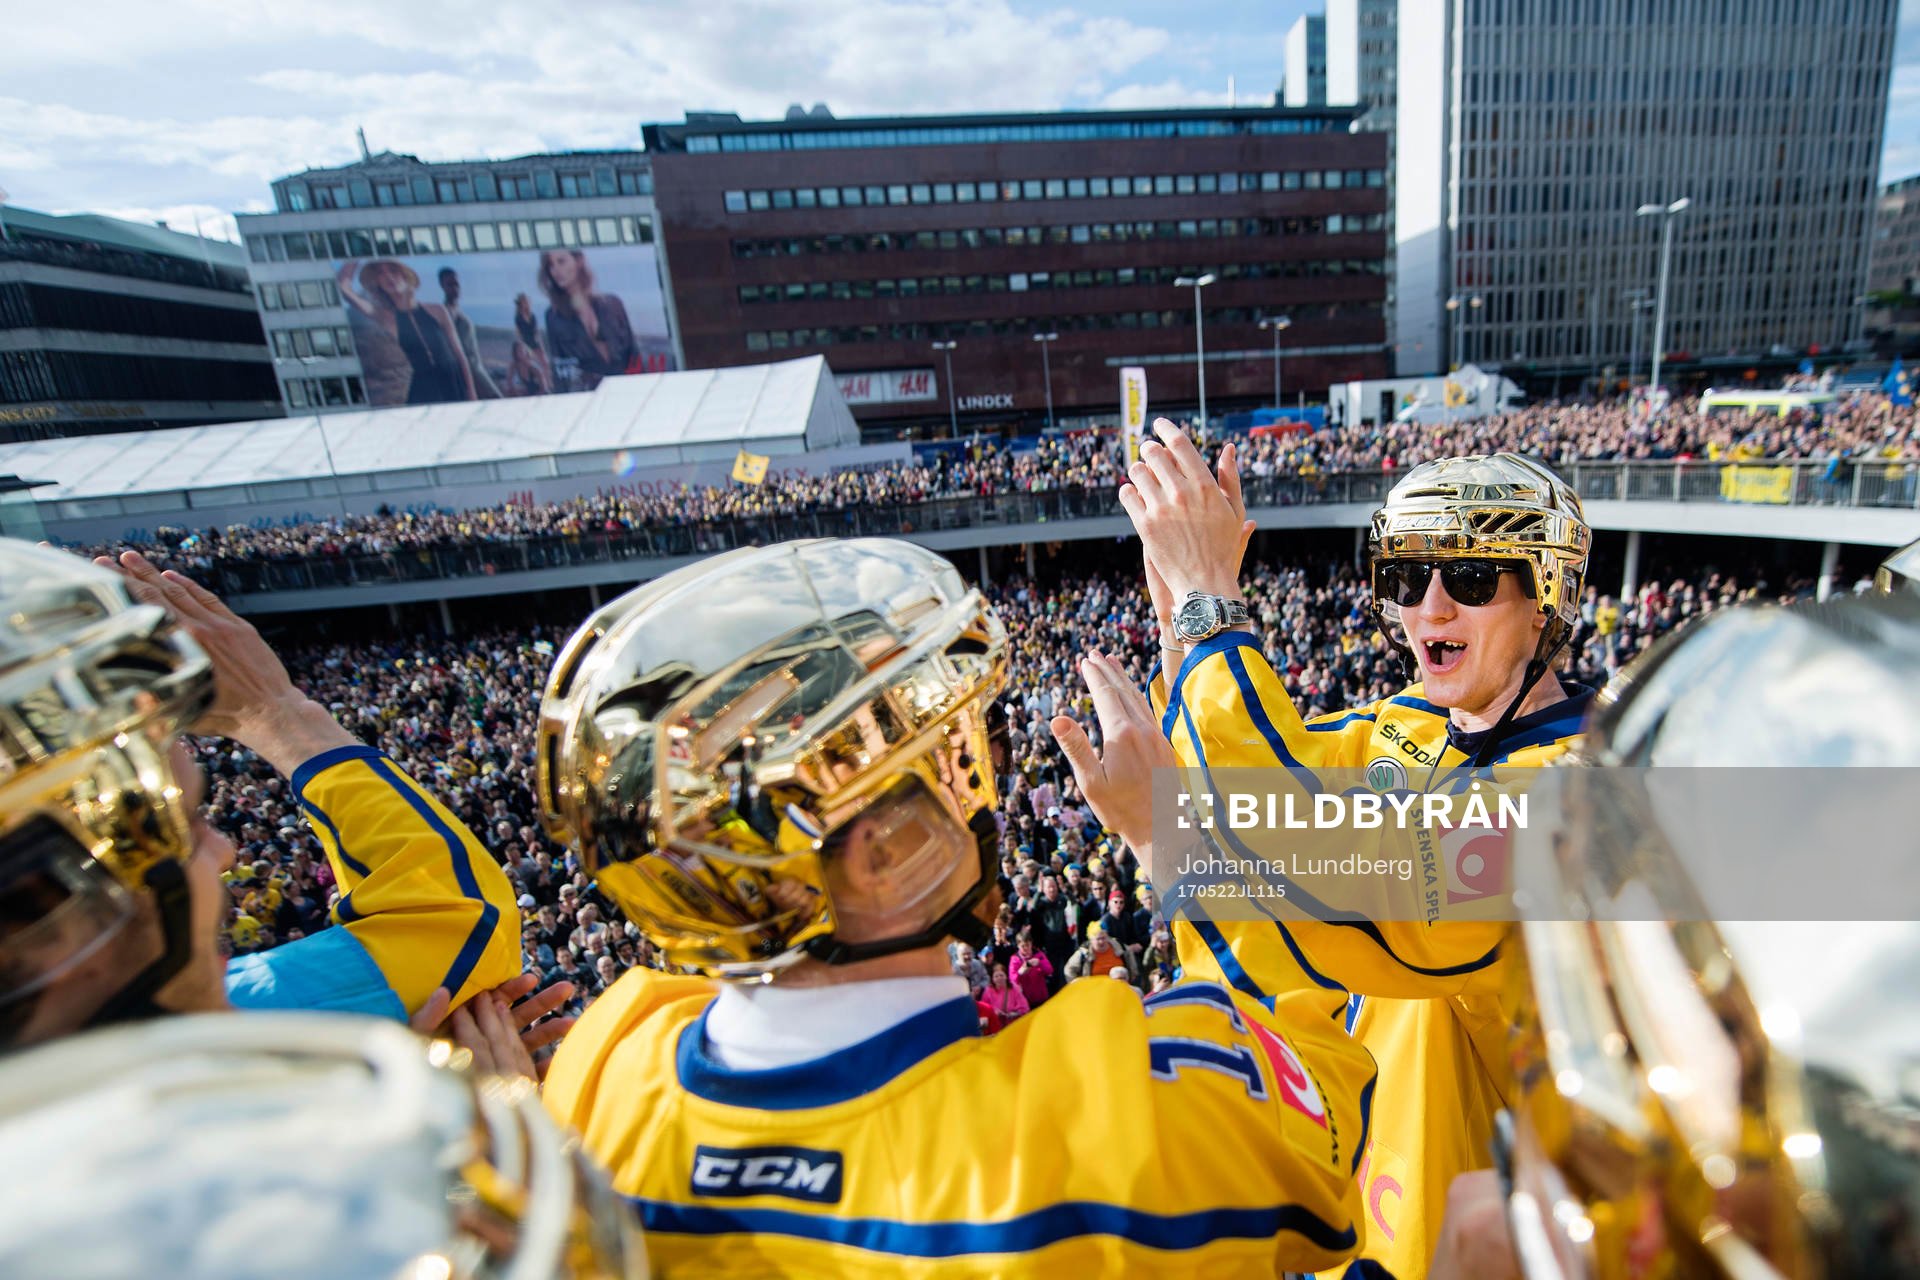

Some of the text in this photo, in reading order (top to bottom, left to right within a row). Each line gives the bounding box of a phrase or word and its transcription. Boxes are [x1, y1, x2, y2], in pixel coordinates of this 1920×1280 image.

[957, 394, 1014, 411] LINDEX
[1379, 723, 1437, 767] ŠKODA
[1411, 808, 1441, 928] SVENSKA SPEL
[693, 1154, 838, 1194] CCM
